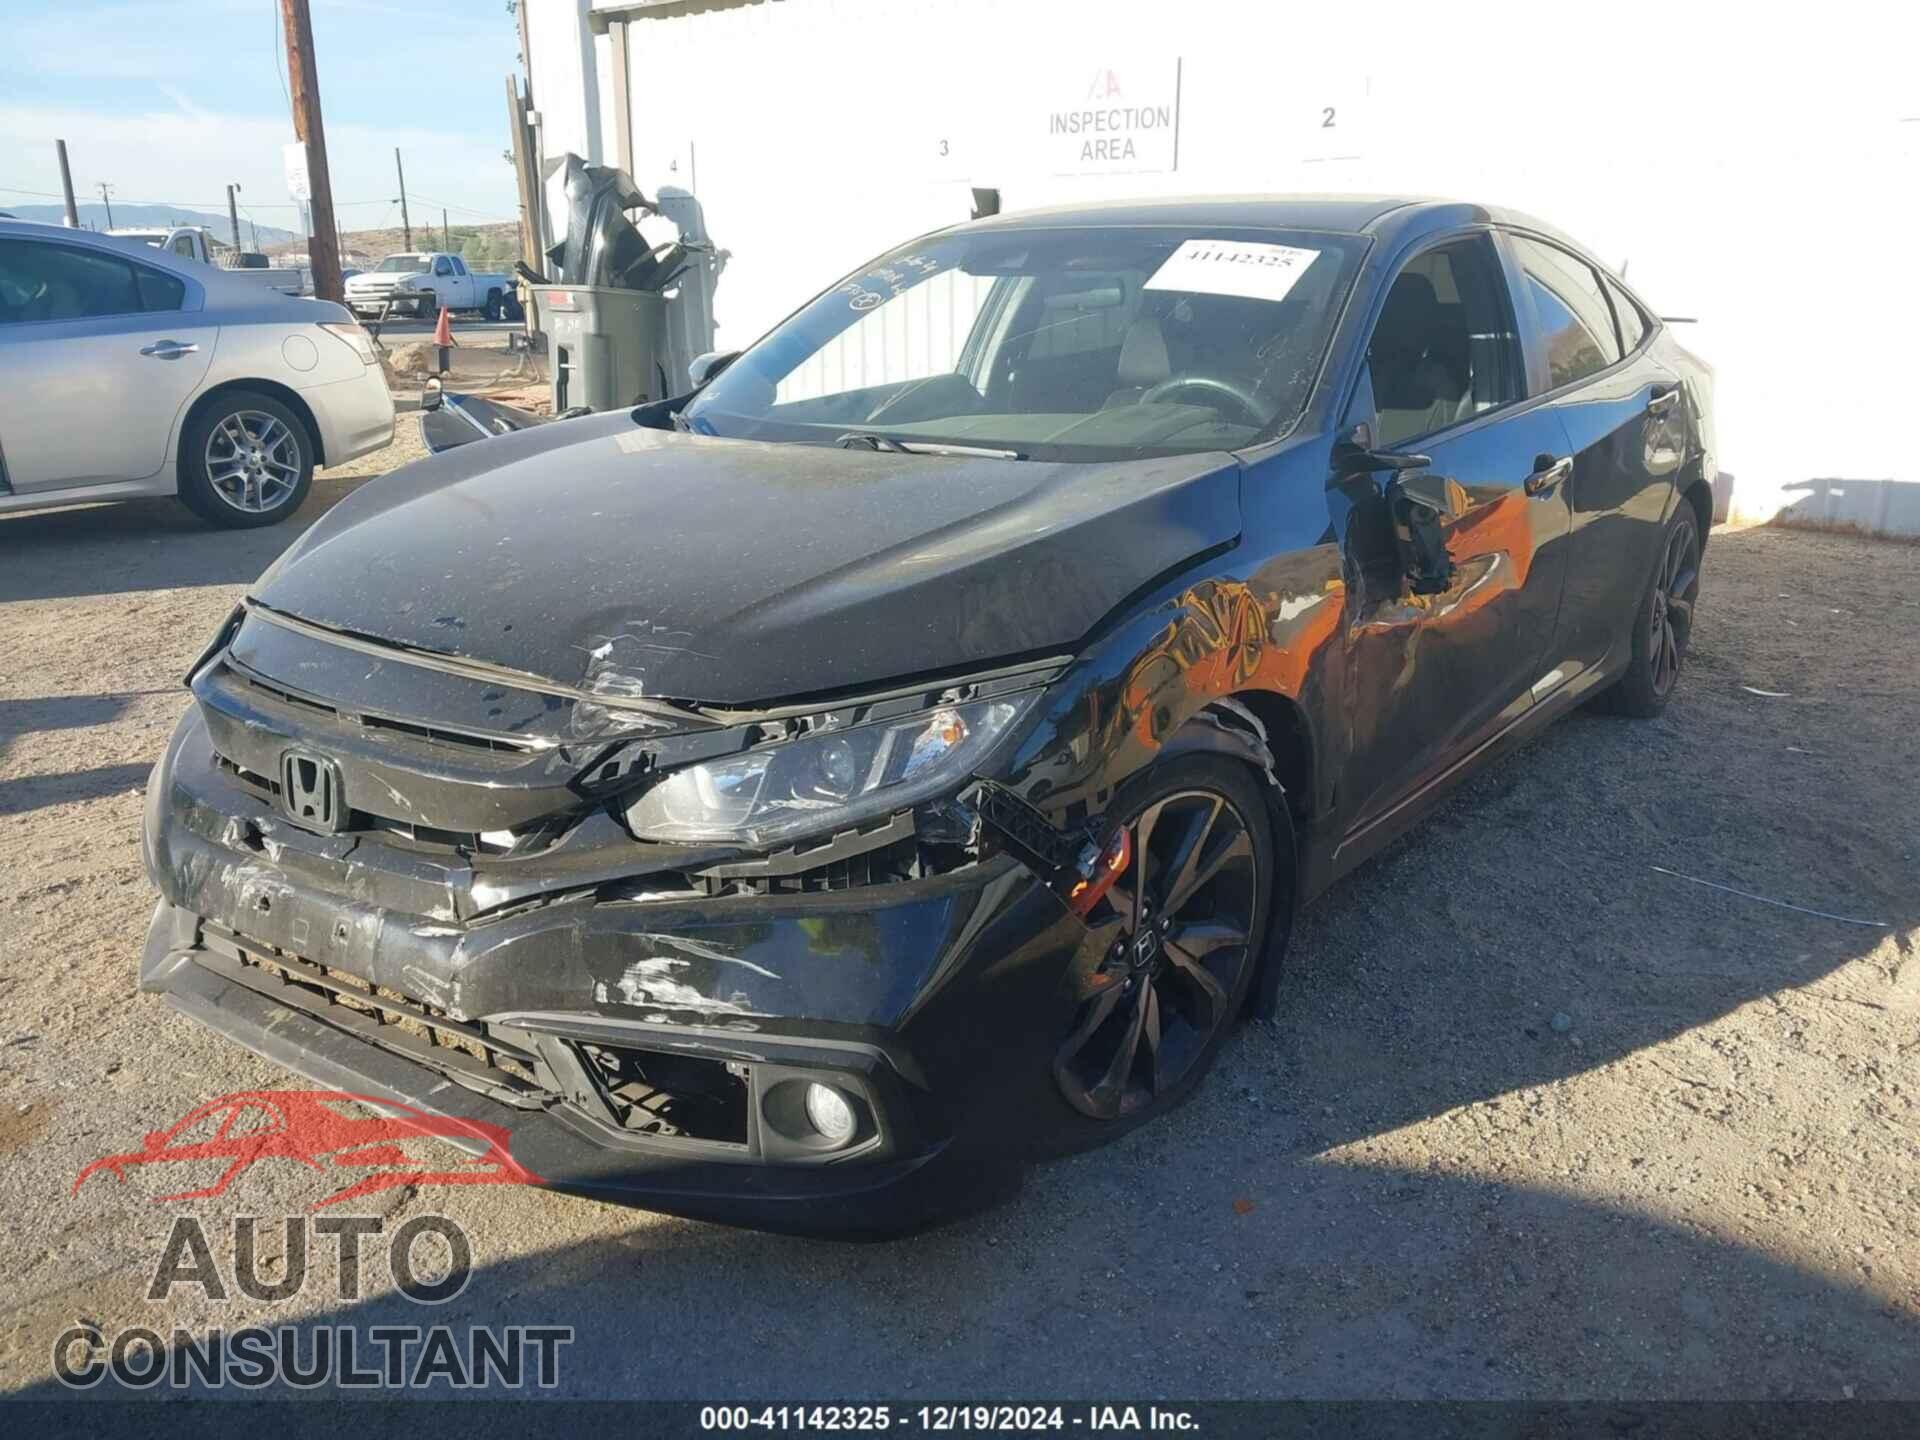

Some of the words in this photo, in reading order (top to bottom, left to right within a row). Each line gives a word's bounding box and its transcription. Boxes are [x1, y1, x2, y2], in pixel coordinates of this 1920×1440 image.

[1049, 105, 1171, 135] INSPECTION
[1321, 106, 1337, 129] 2
[938, 138, 951, 158] 3
[1079, 137, 1137, 162] AREA
[669, 158, 679, 174] 4
